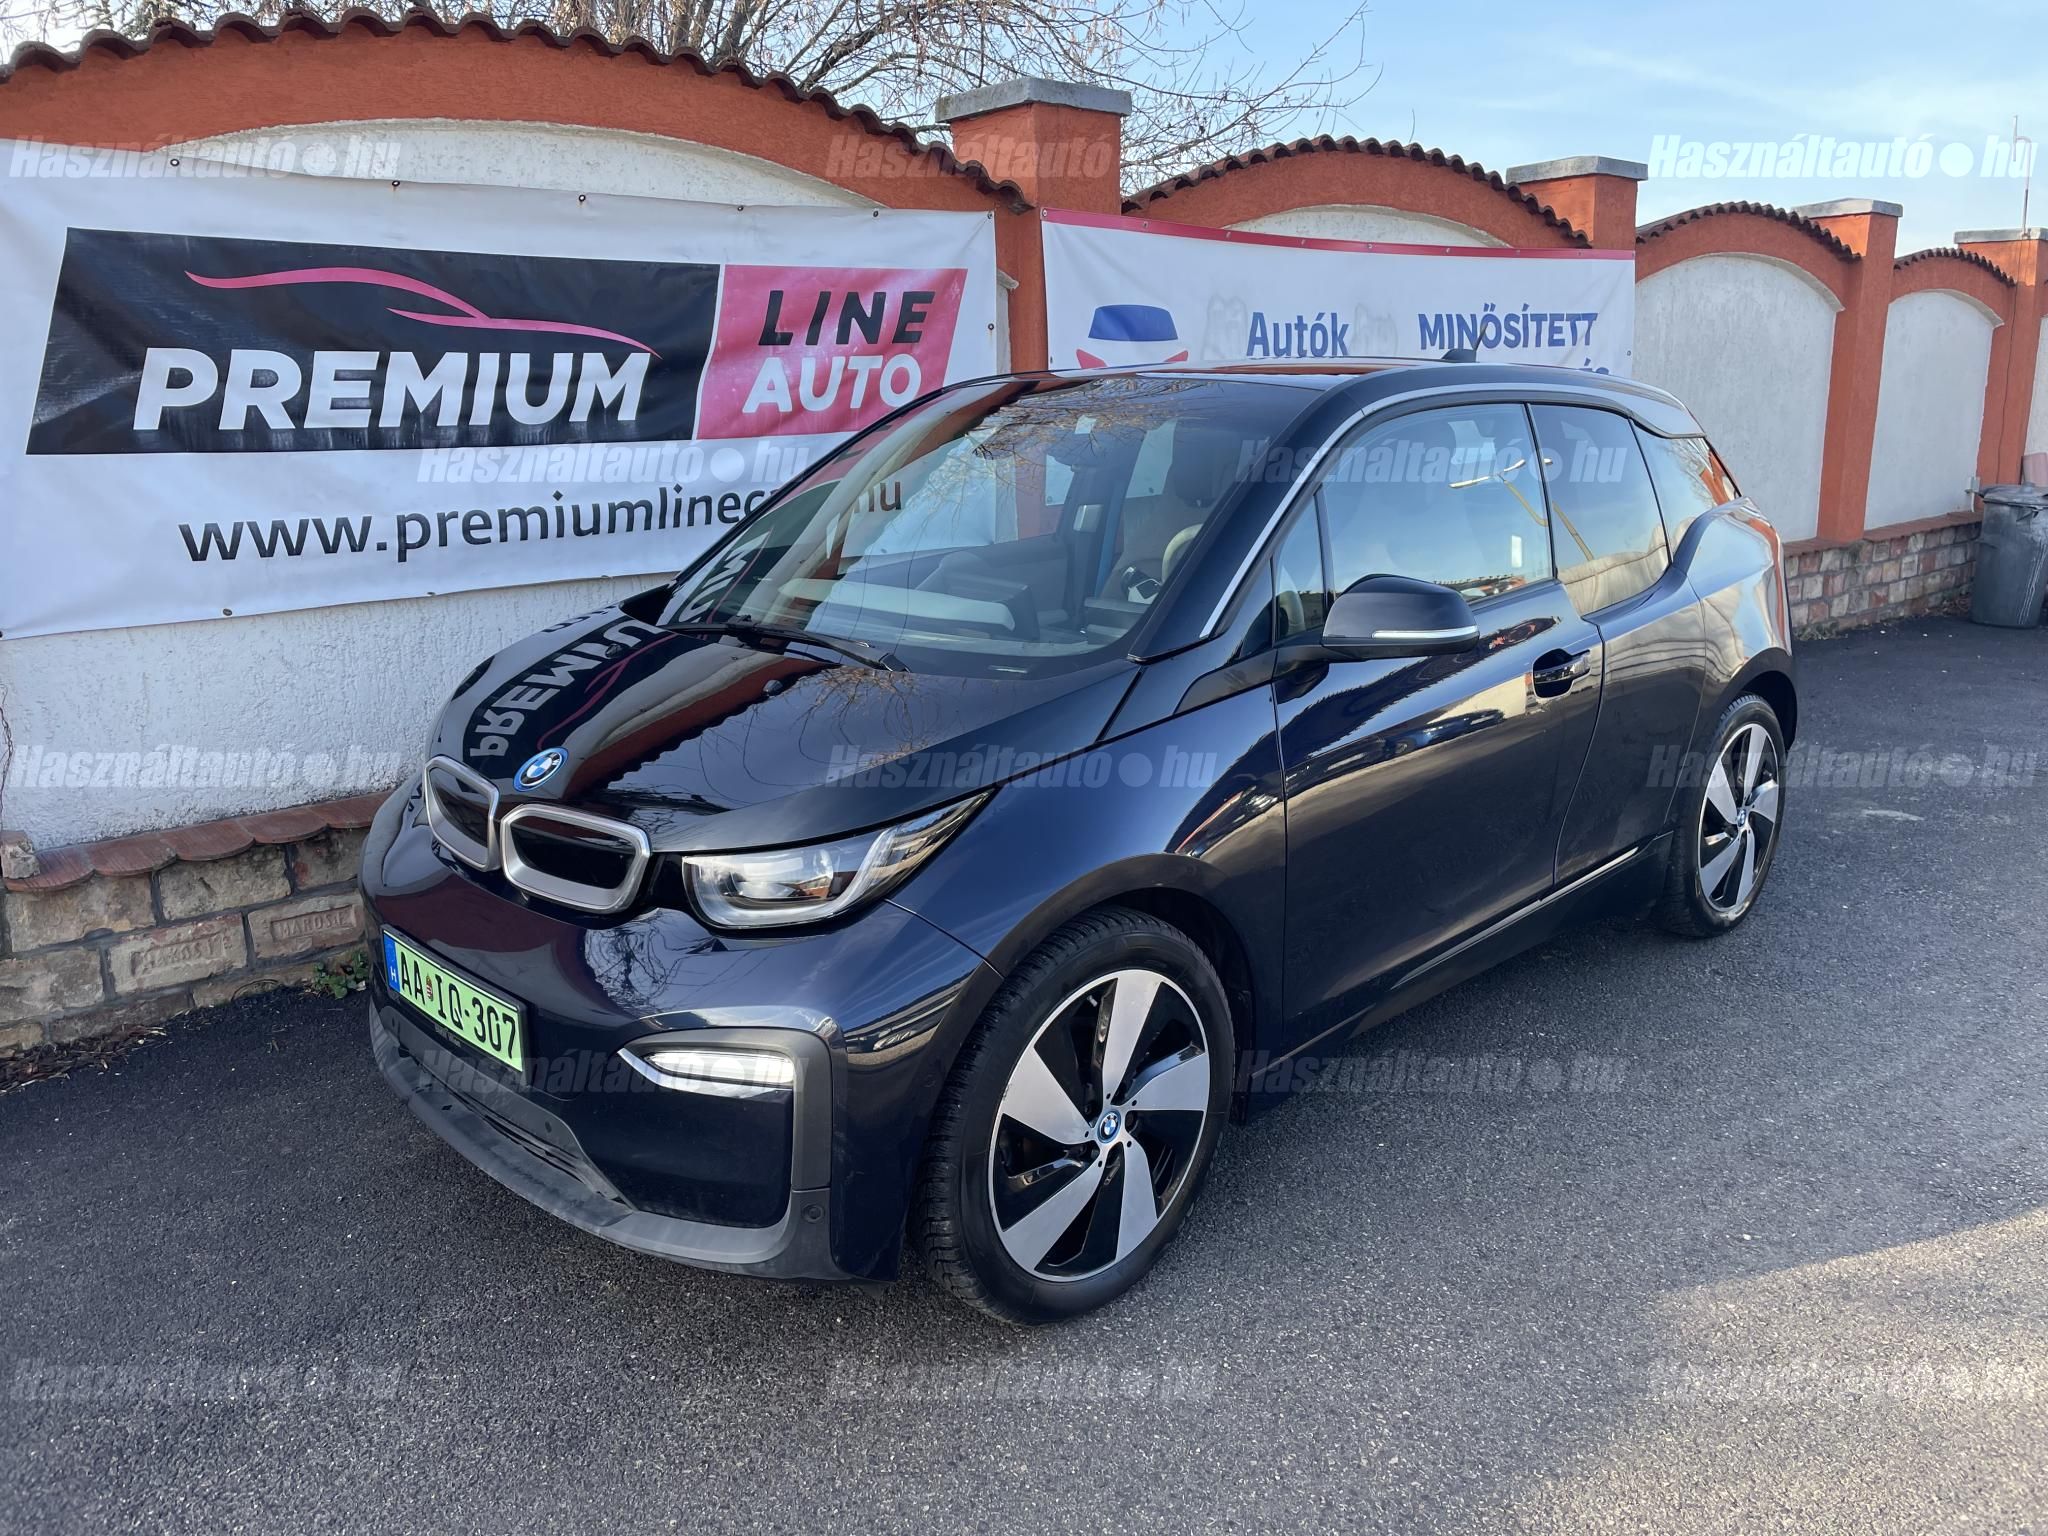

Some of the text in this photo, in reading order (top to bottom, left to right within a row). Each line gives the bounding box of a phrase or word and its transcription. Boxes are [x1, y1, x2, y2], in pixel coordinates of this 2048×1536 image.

[758, 290, 936, 346] LINE
[1246, 312, 1350, 358] Autók
[1418, 303, 1598, 350] MINŐSÍTETT
[133, 347, 652, 431] PREMIUM
[742, 353, 922, 414] AUTO
[389, 966, 398, 983] H
